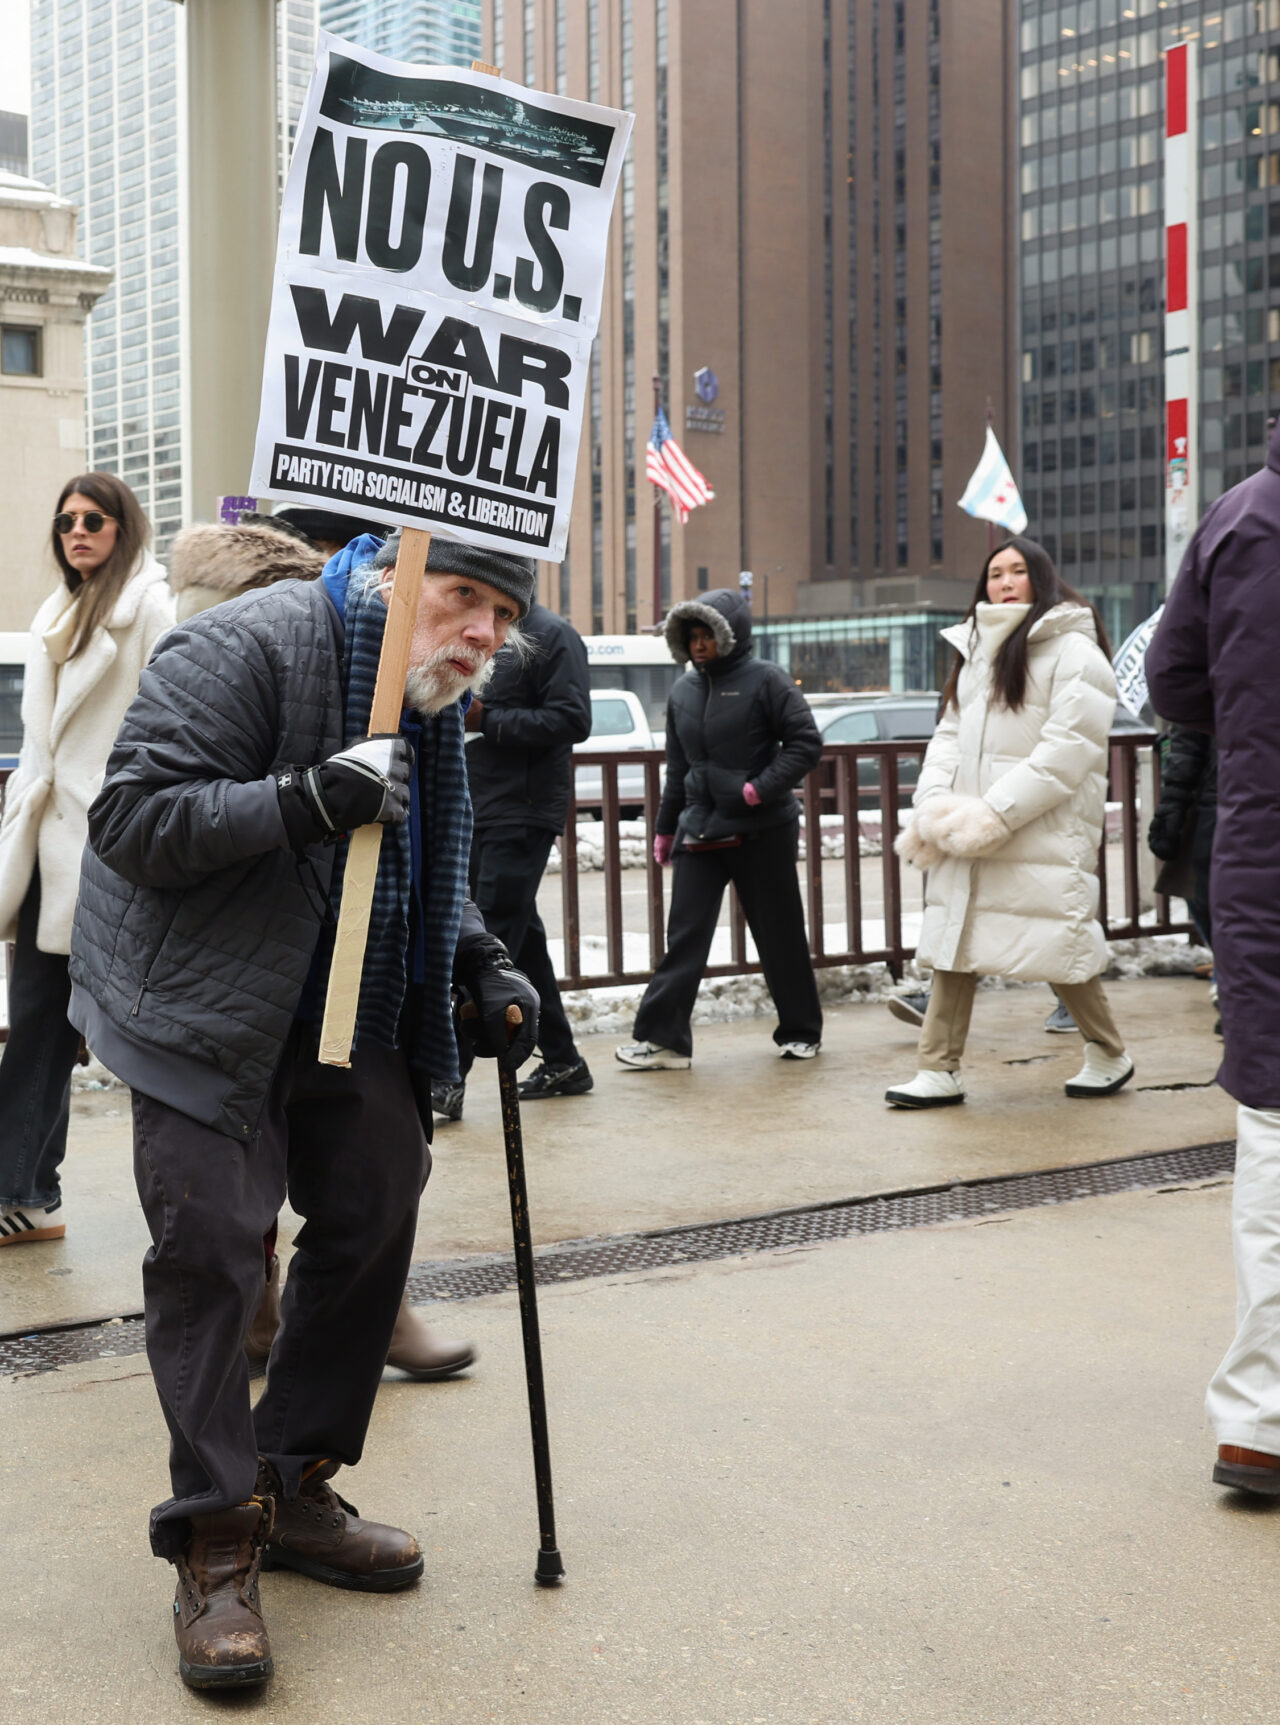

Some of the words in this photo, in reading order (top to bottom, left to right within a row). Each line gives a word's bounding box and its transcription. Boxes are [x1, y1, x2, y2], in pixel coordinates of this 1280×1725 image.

[298, 125, 432, 273] NO
[441, 152, 582, 322] U.S.
[289, 284, 572, 411] WAR
[411, 364, 461, 392] ON
[284, 354, 561, 499] VENEZUELA
[276, 454, 332, 488] PARTY
[332, 464, 365, 495] FOR
[366, 471, 448, 513] SOCIALISM
[447, 492, 466, 519] &
[468, 495, 548, 537] LIBERATION
